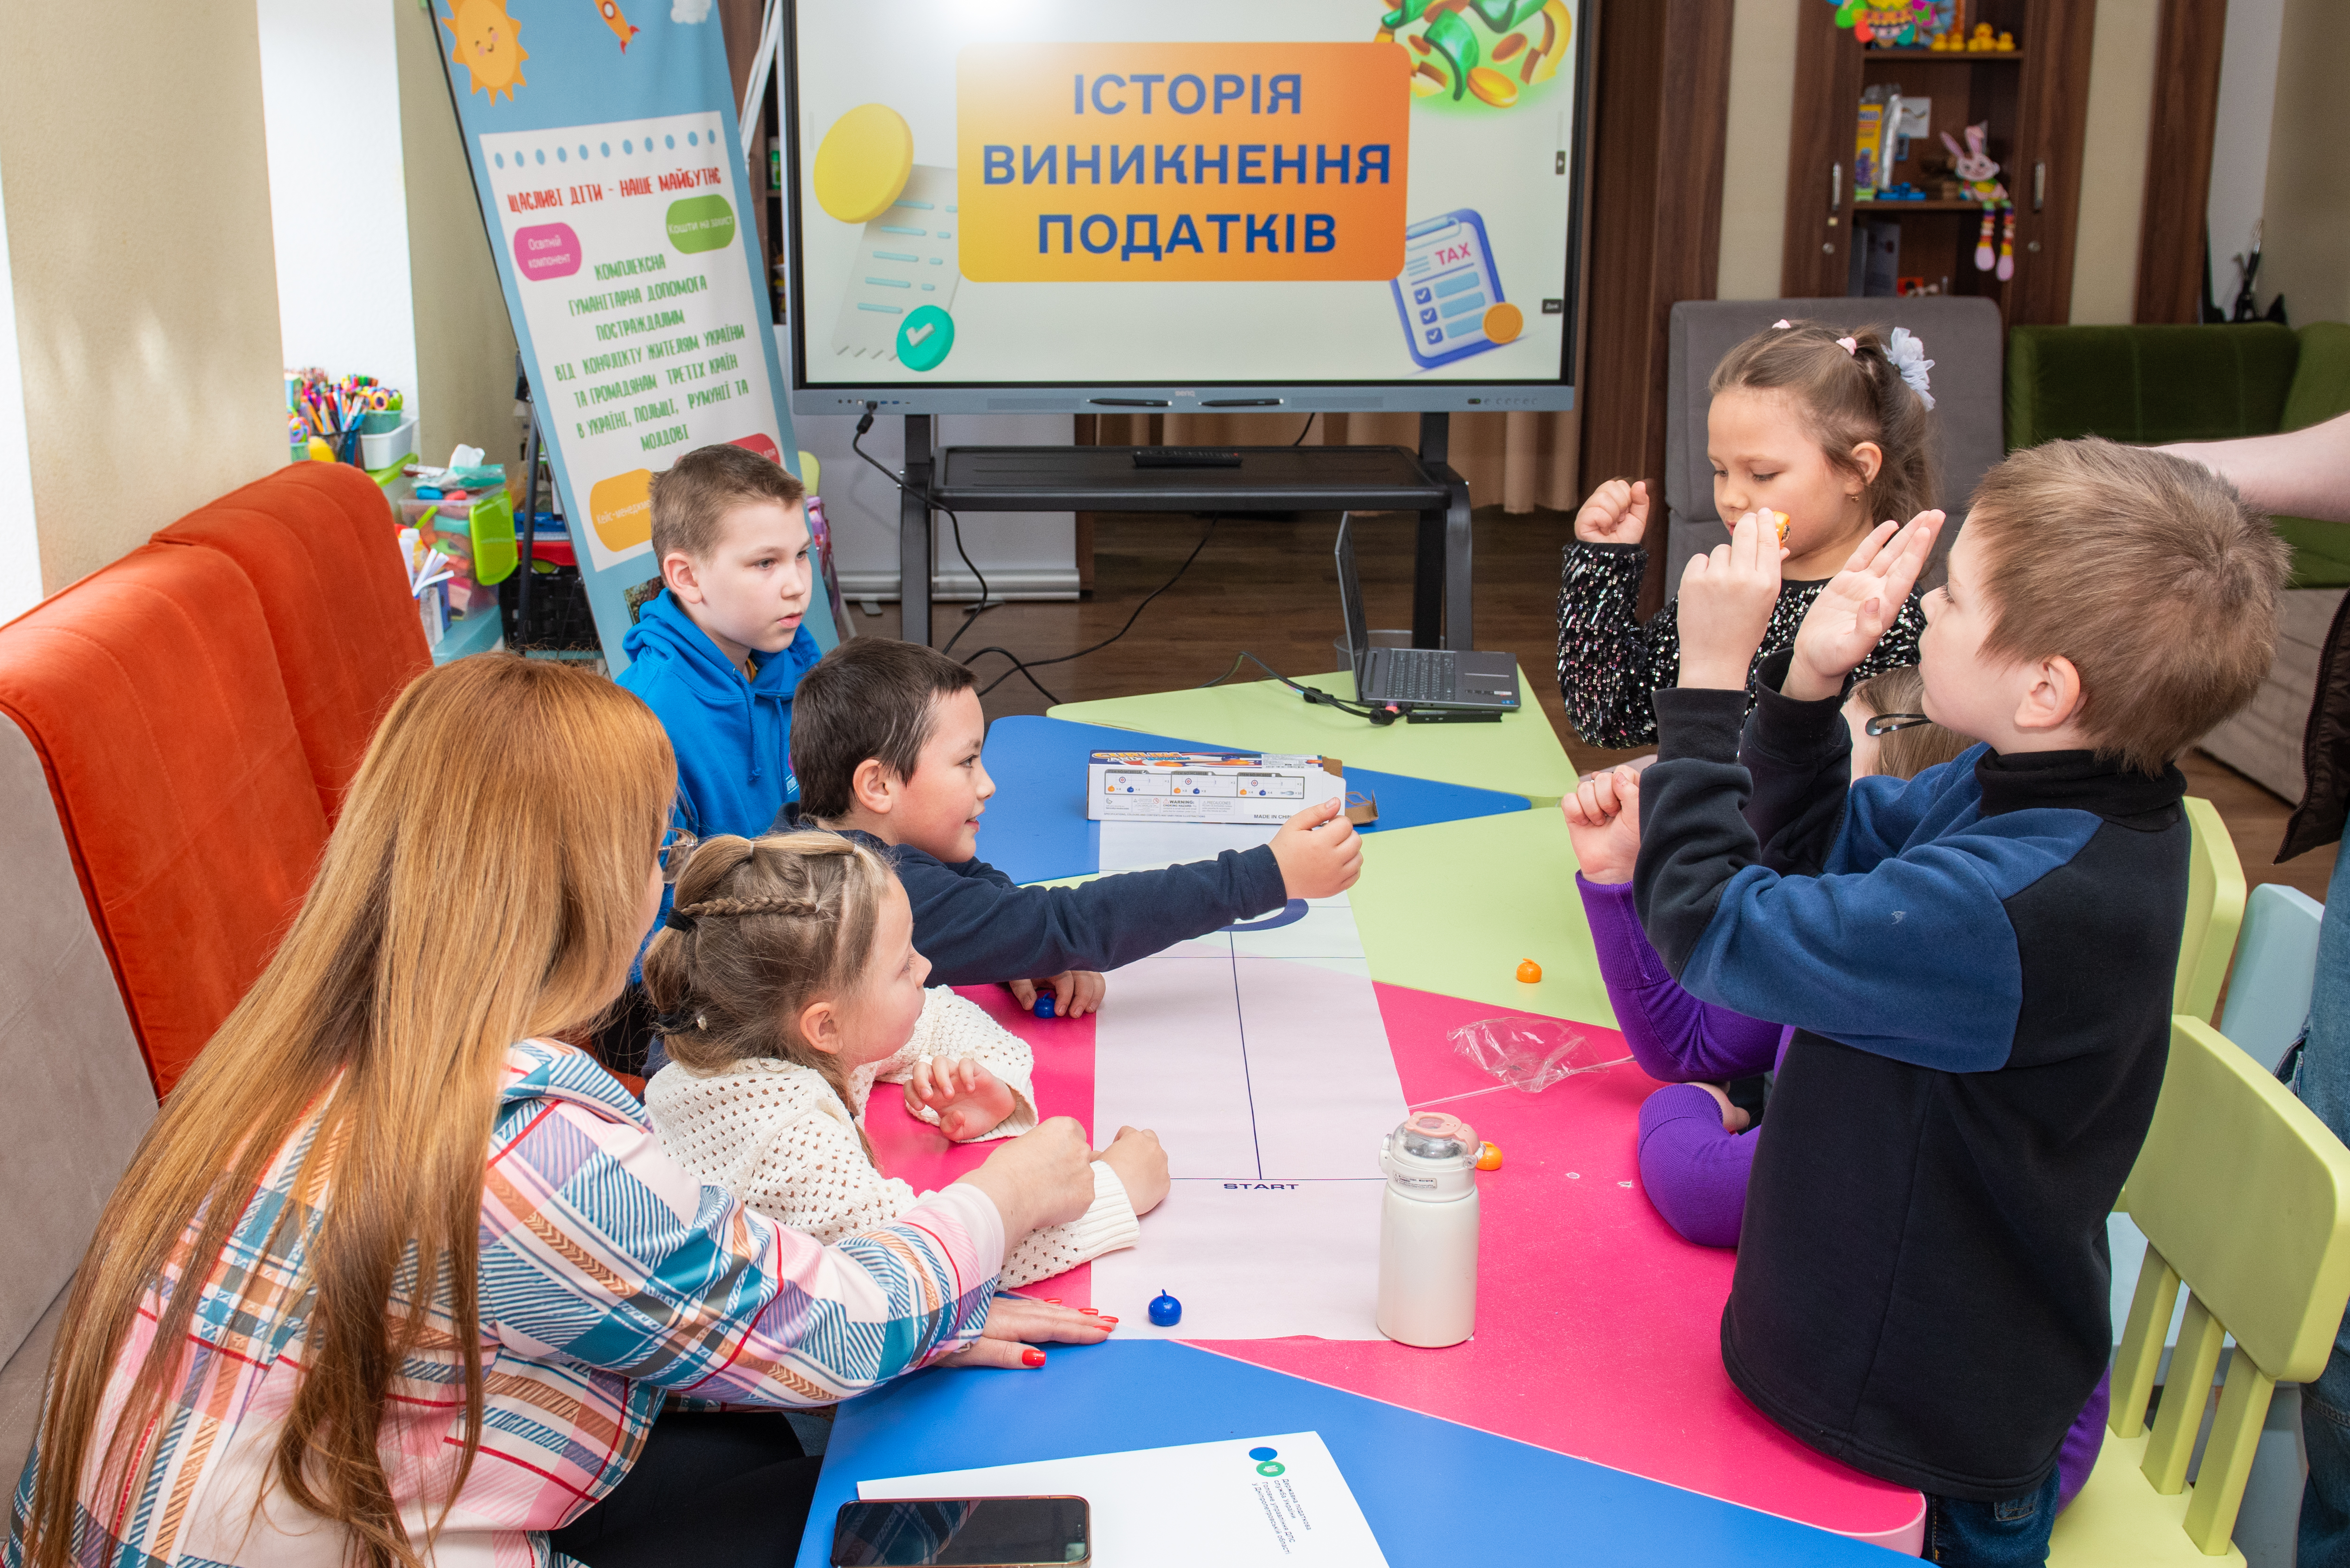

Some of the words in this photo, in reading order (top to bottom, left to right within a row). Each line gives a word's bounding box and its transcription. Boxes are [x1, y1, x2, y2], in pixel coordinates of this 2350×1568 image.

[1074, 73, 1302, 115] ІСТОРІЯ
[983, 144, 1391, 184] ВИНИКНЕННЯ
[507, 188, 564, 214] ЩАСЛИВІ
[570, 184, 603, 206] ДІТИ
[619, 176, 654, 198] НАШЕ
[668, 222, 698, 234] Кошти
[1038, 214, 1337, 261] ПОДАТКІВ
[528, 254, 570, 269] компонент
[593, 253, 666, 281] КОМПЛЕКСНА
[1435, 242, 1471, 266] TAX
[568, 287, 643, 317] ГУМАНІТАРНА
[647, 274, 708, 302] ДОПОМОГА
[595, 309, 686, 341] ПОСТРАЖДАЛИМ
[554, 362, 577, 382] ВІД
[582, 346, 642, 375] КОНФЛІКТУ
[646, 335, 700, 361] ЖИТЕЛЯМ
[703, 323, 746, 347] УКРАЇНИ
[573, 391, 588, 408] ТА
[589, 374, 658, 405] ГРОМАДЯНАМ
[666, 361, 707, 385] ТРЕТІХ
[708, 352, 739, 375] КРАЇН
[576, 422, 585, 439] В
[586, 410, 632, 436] УКРАЇНІ,
[634, 398, 679, 423] ПОЛЬЩІ,
[686, 380, 732, 409] РУМУНІЇ
[734, 378, 749, 397] ТА
[640, 423, 690, 452] МОЛДОВІ
[595, 499, 652, 525] Кейс-менеджме
[1262, 1482, 1275, 1502] Головне
[1270, 1502, 1289, 1530] управління
[1284, 1531, 1295, 1543] ДПС
[1274, 1480, 1287, 1498] служба
[1283, 1499, 1296, 1519] України
[1281, 1479, 1298, 1503] Державна
[1295, 1504, 1311, 1530] податкова
[1254, 1487, 1282, 1534] Дніпропетровській
[1278, 1535, 1292, 1554] області
